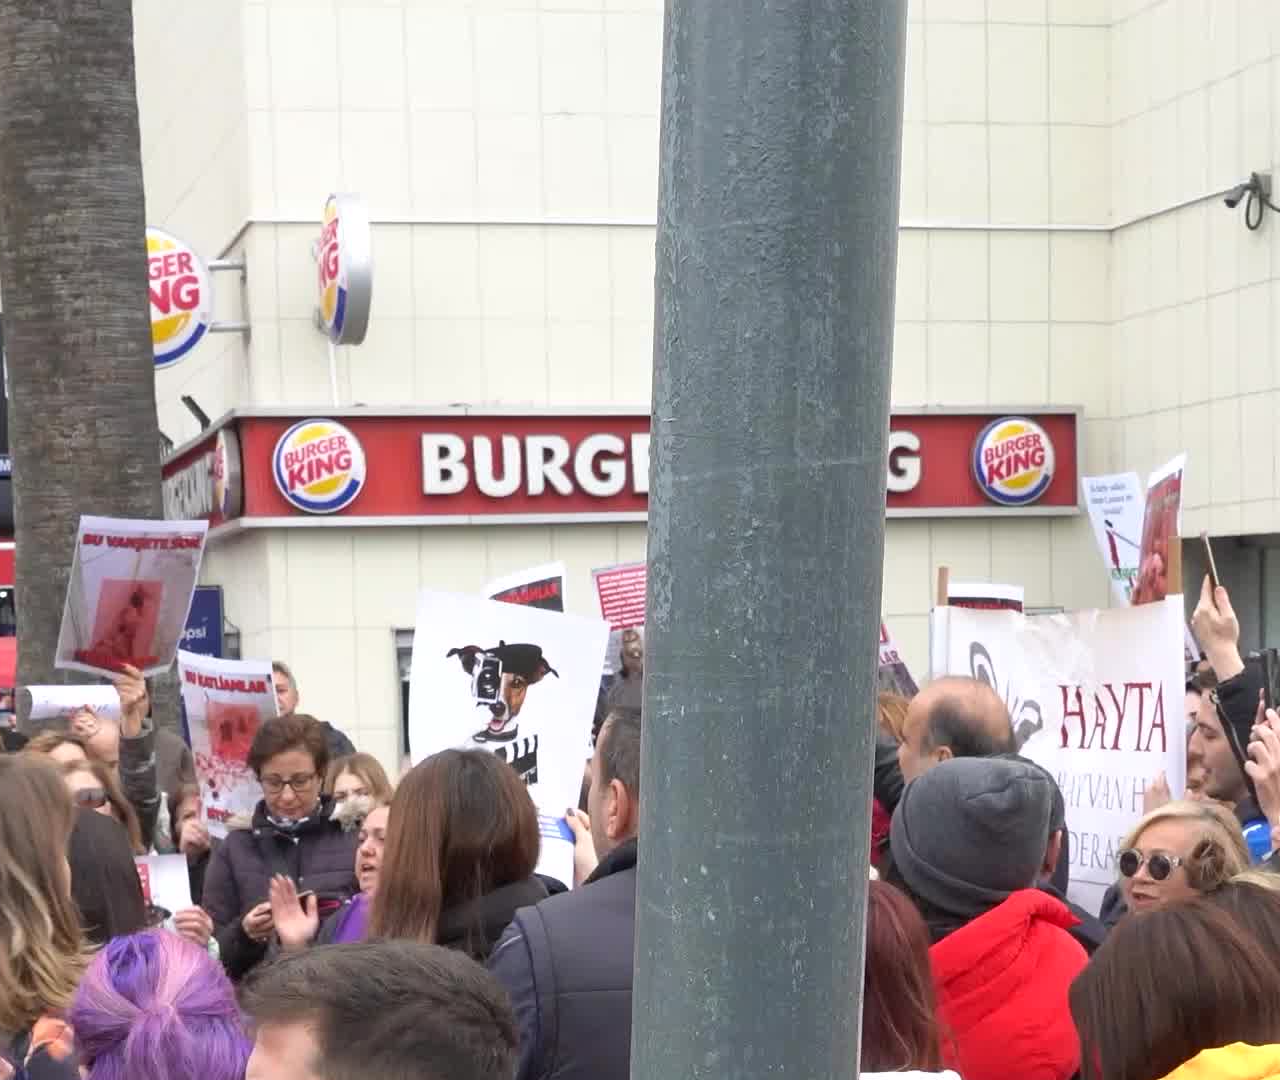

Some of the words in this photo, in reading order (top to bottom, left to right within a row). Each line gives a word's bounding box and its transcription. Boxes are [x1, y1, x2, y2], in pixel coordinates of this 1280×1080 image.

[146, 252, 194, 280] GER
[148, 275, 200, 315] NG
[284, 435, 348, 470] BURGER
[983, 433, 1042, 464] BURGER
[288, 450, 352, 490] KING
[985, 449, 1047, 486] KING
[1057, 680, 1167, 753] HAYTA
